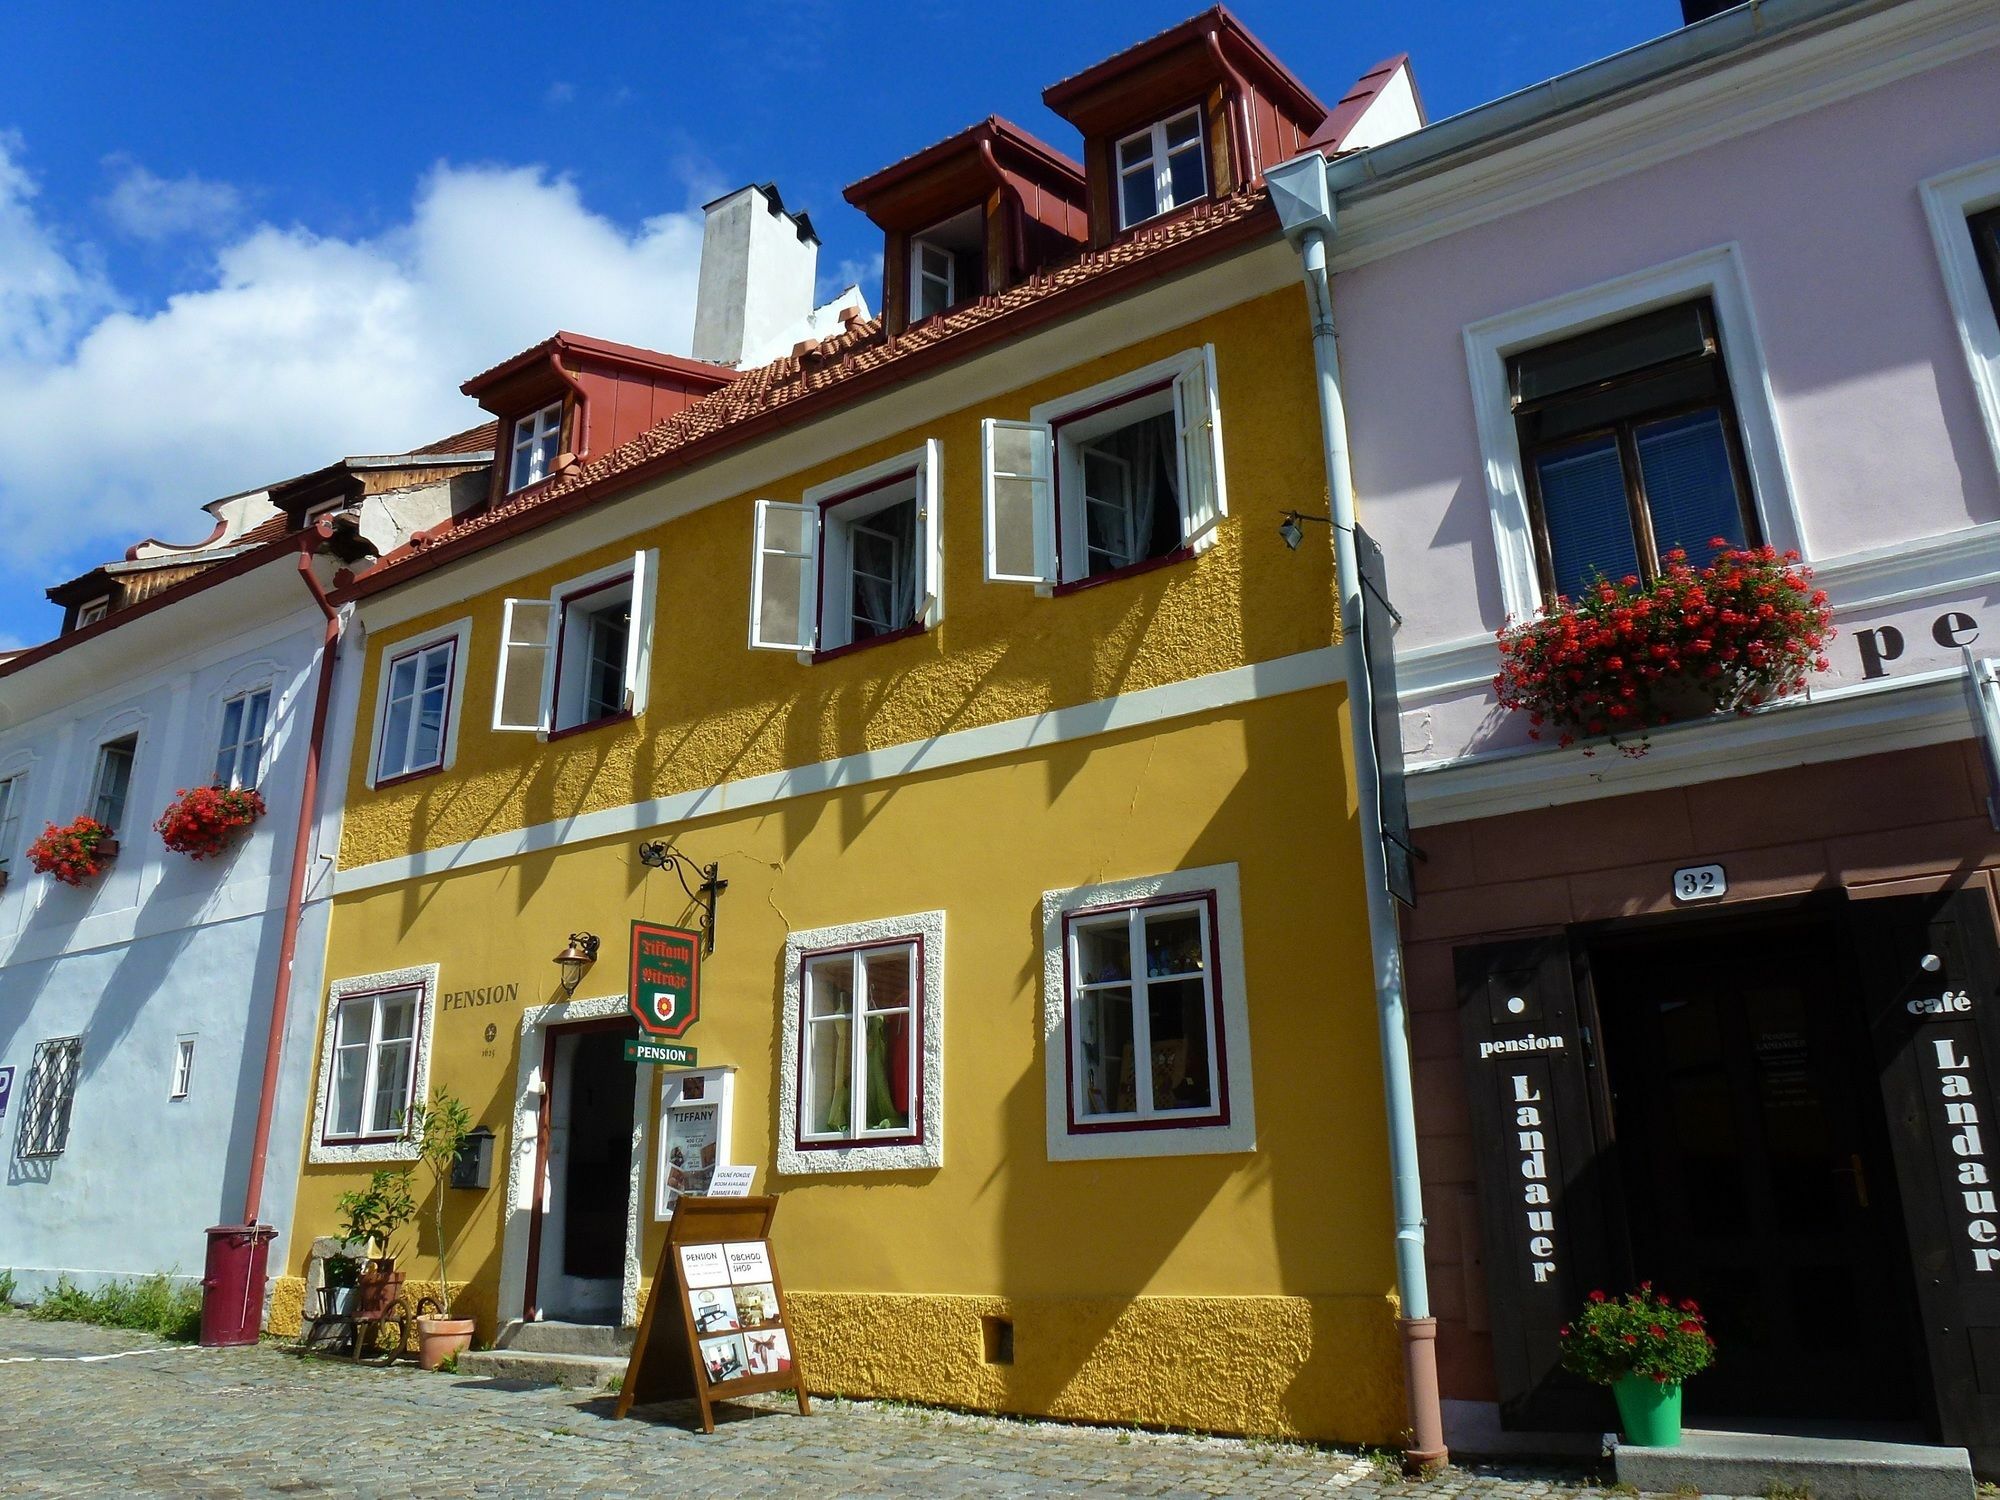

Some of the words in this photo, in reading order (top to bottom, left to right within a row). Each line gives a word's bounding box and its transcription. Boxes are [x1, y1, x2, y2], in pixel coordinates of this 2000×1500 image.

[1683, 872, 1715, 893] 32
[442, 983, 519, 1012] PENSION
[1907, 990, 1972, 1015] café
[636, 1045, 687, 1062] PENSION
[1480, 1033, 1564, 1059] pension
[673, 1111, 714, 1122] TIFFANY
[1932, 1039, 2000, 1272] Landauer
[1511, 1075, 1556, 1283] Landauer
[685, 1252, 718, 1262] PENSION
[730, 1252, 761, 1262] OBCHOD
[733, 1264, 752, 1273] SHOP
